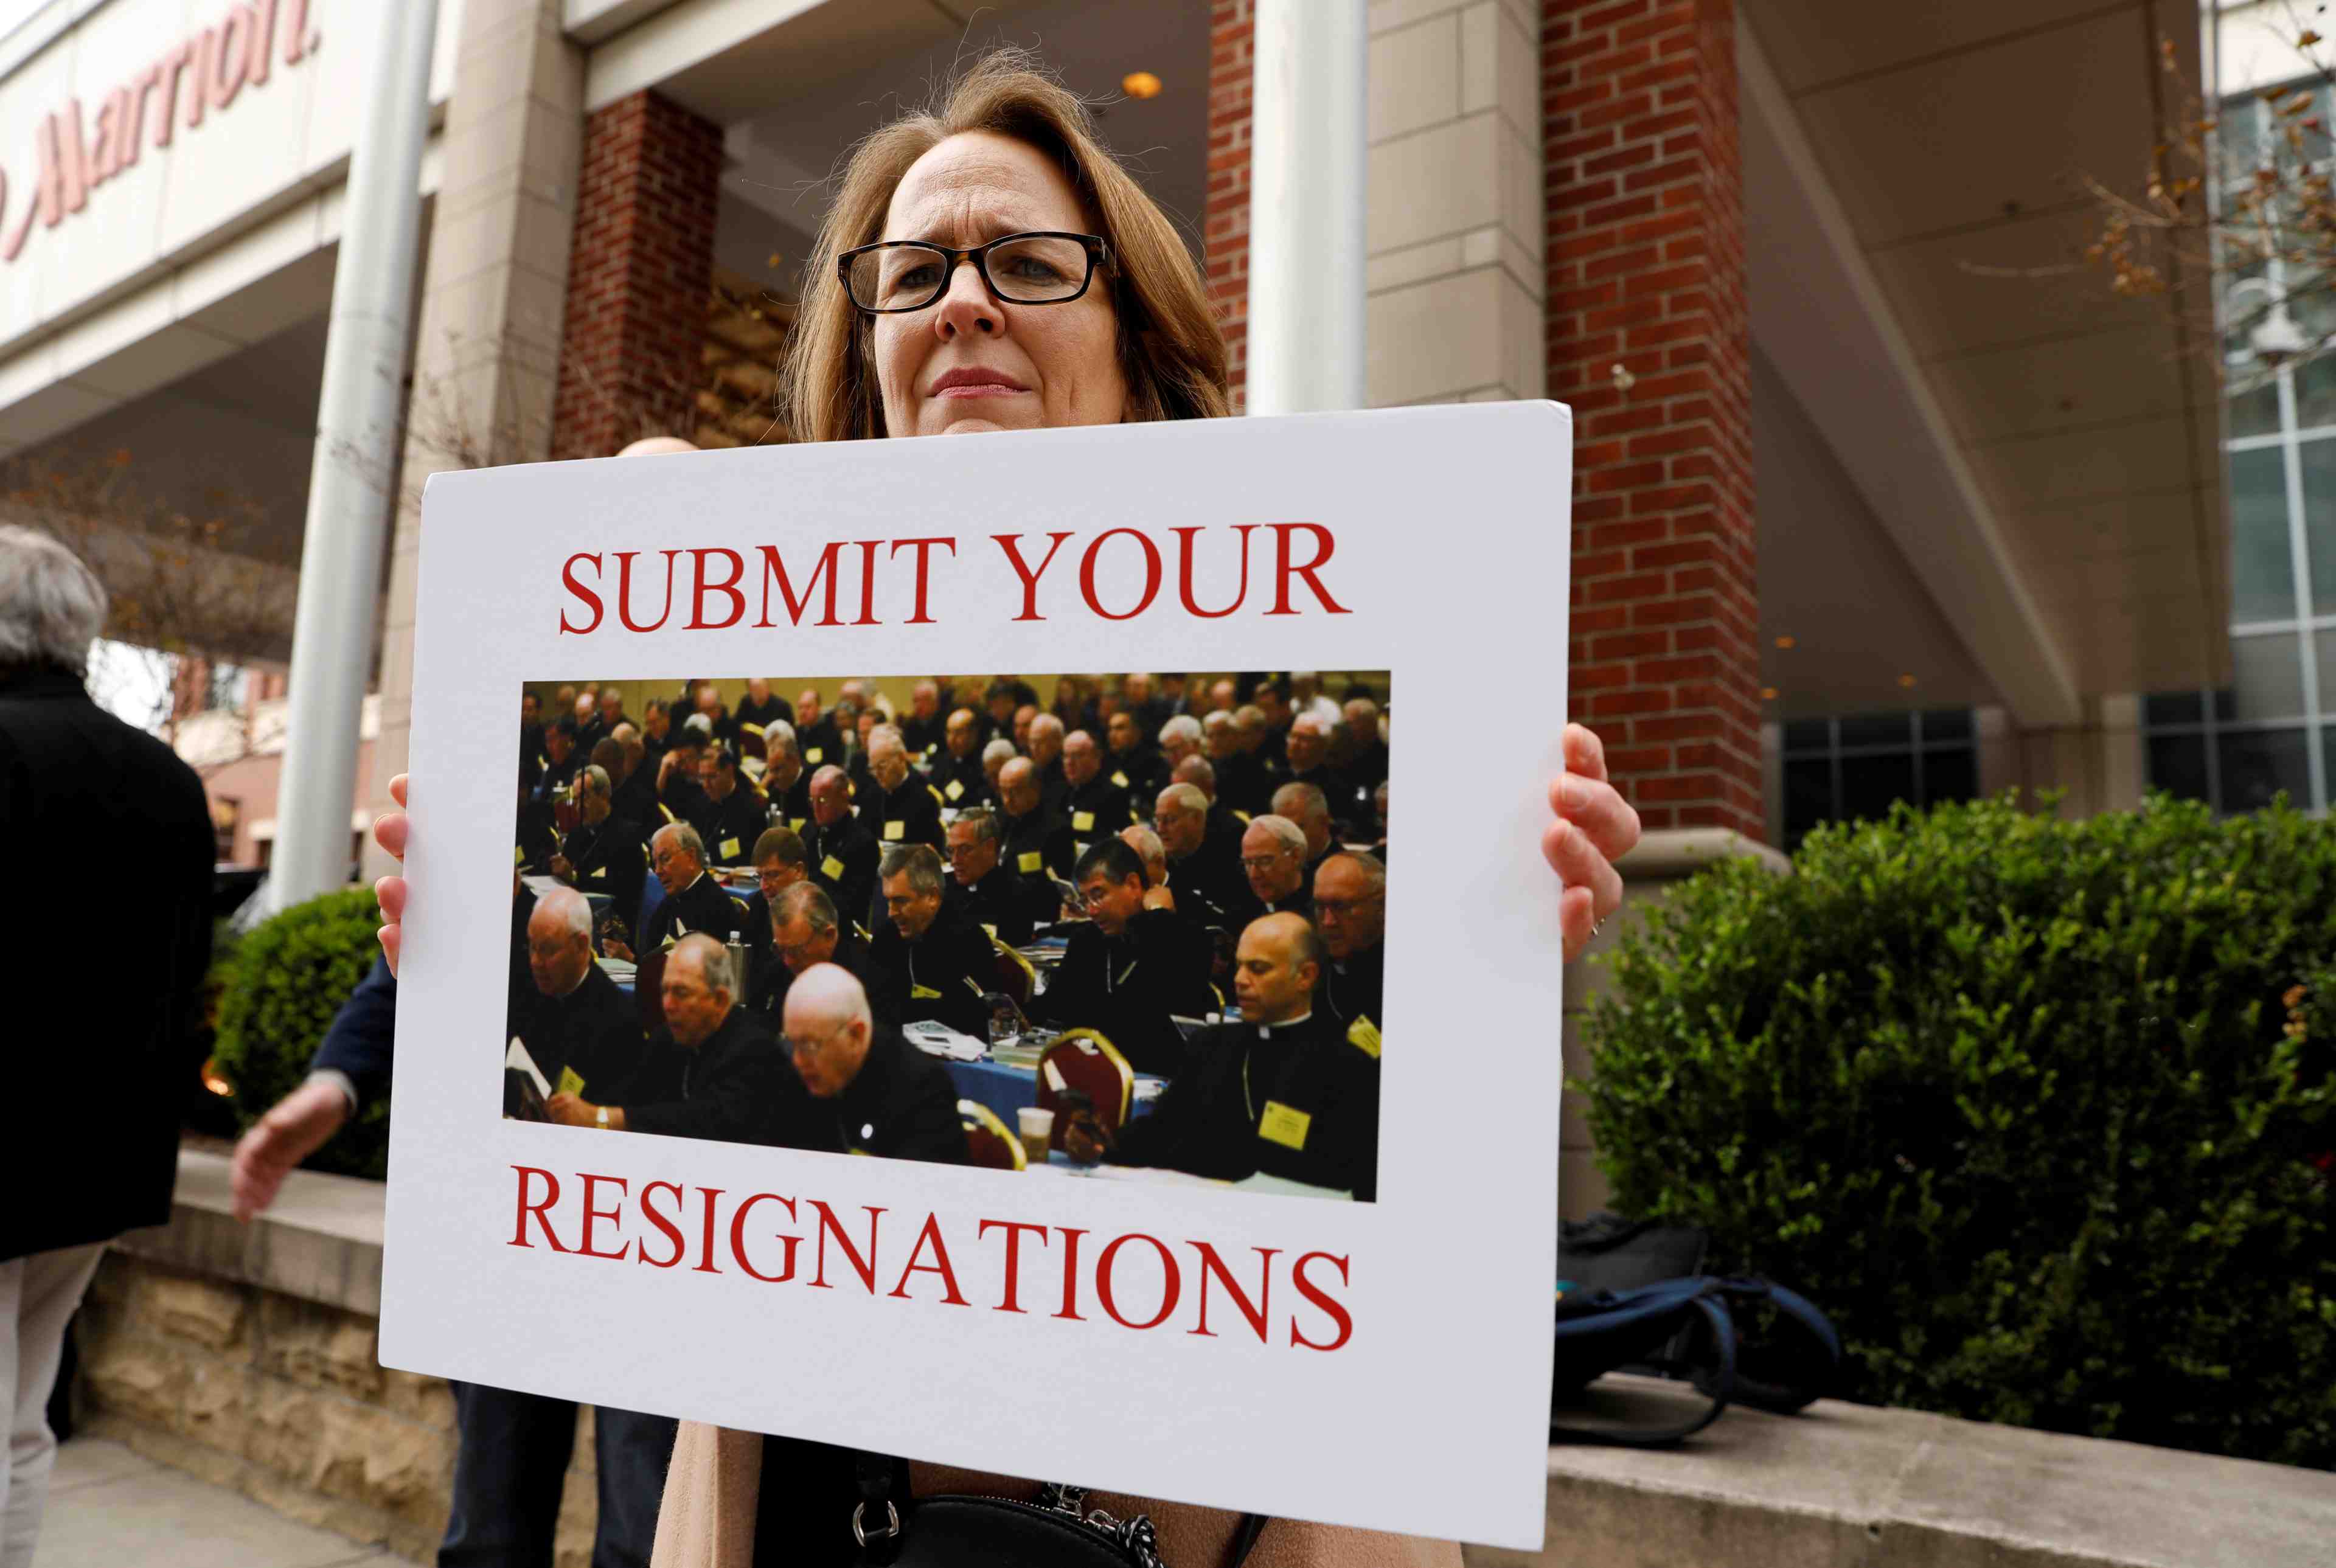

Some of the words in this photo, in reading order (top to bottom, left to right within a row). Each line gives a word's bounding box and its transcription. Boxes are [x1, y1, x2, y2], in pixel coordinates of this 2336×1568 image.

[559, 537, 958, 636] SUBMIT
[992, 522, 1354, 622] YOUR
[507, 1165, 1354, 1353] RESIGNATIONS
